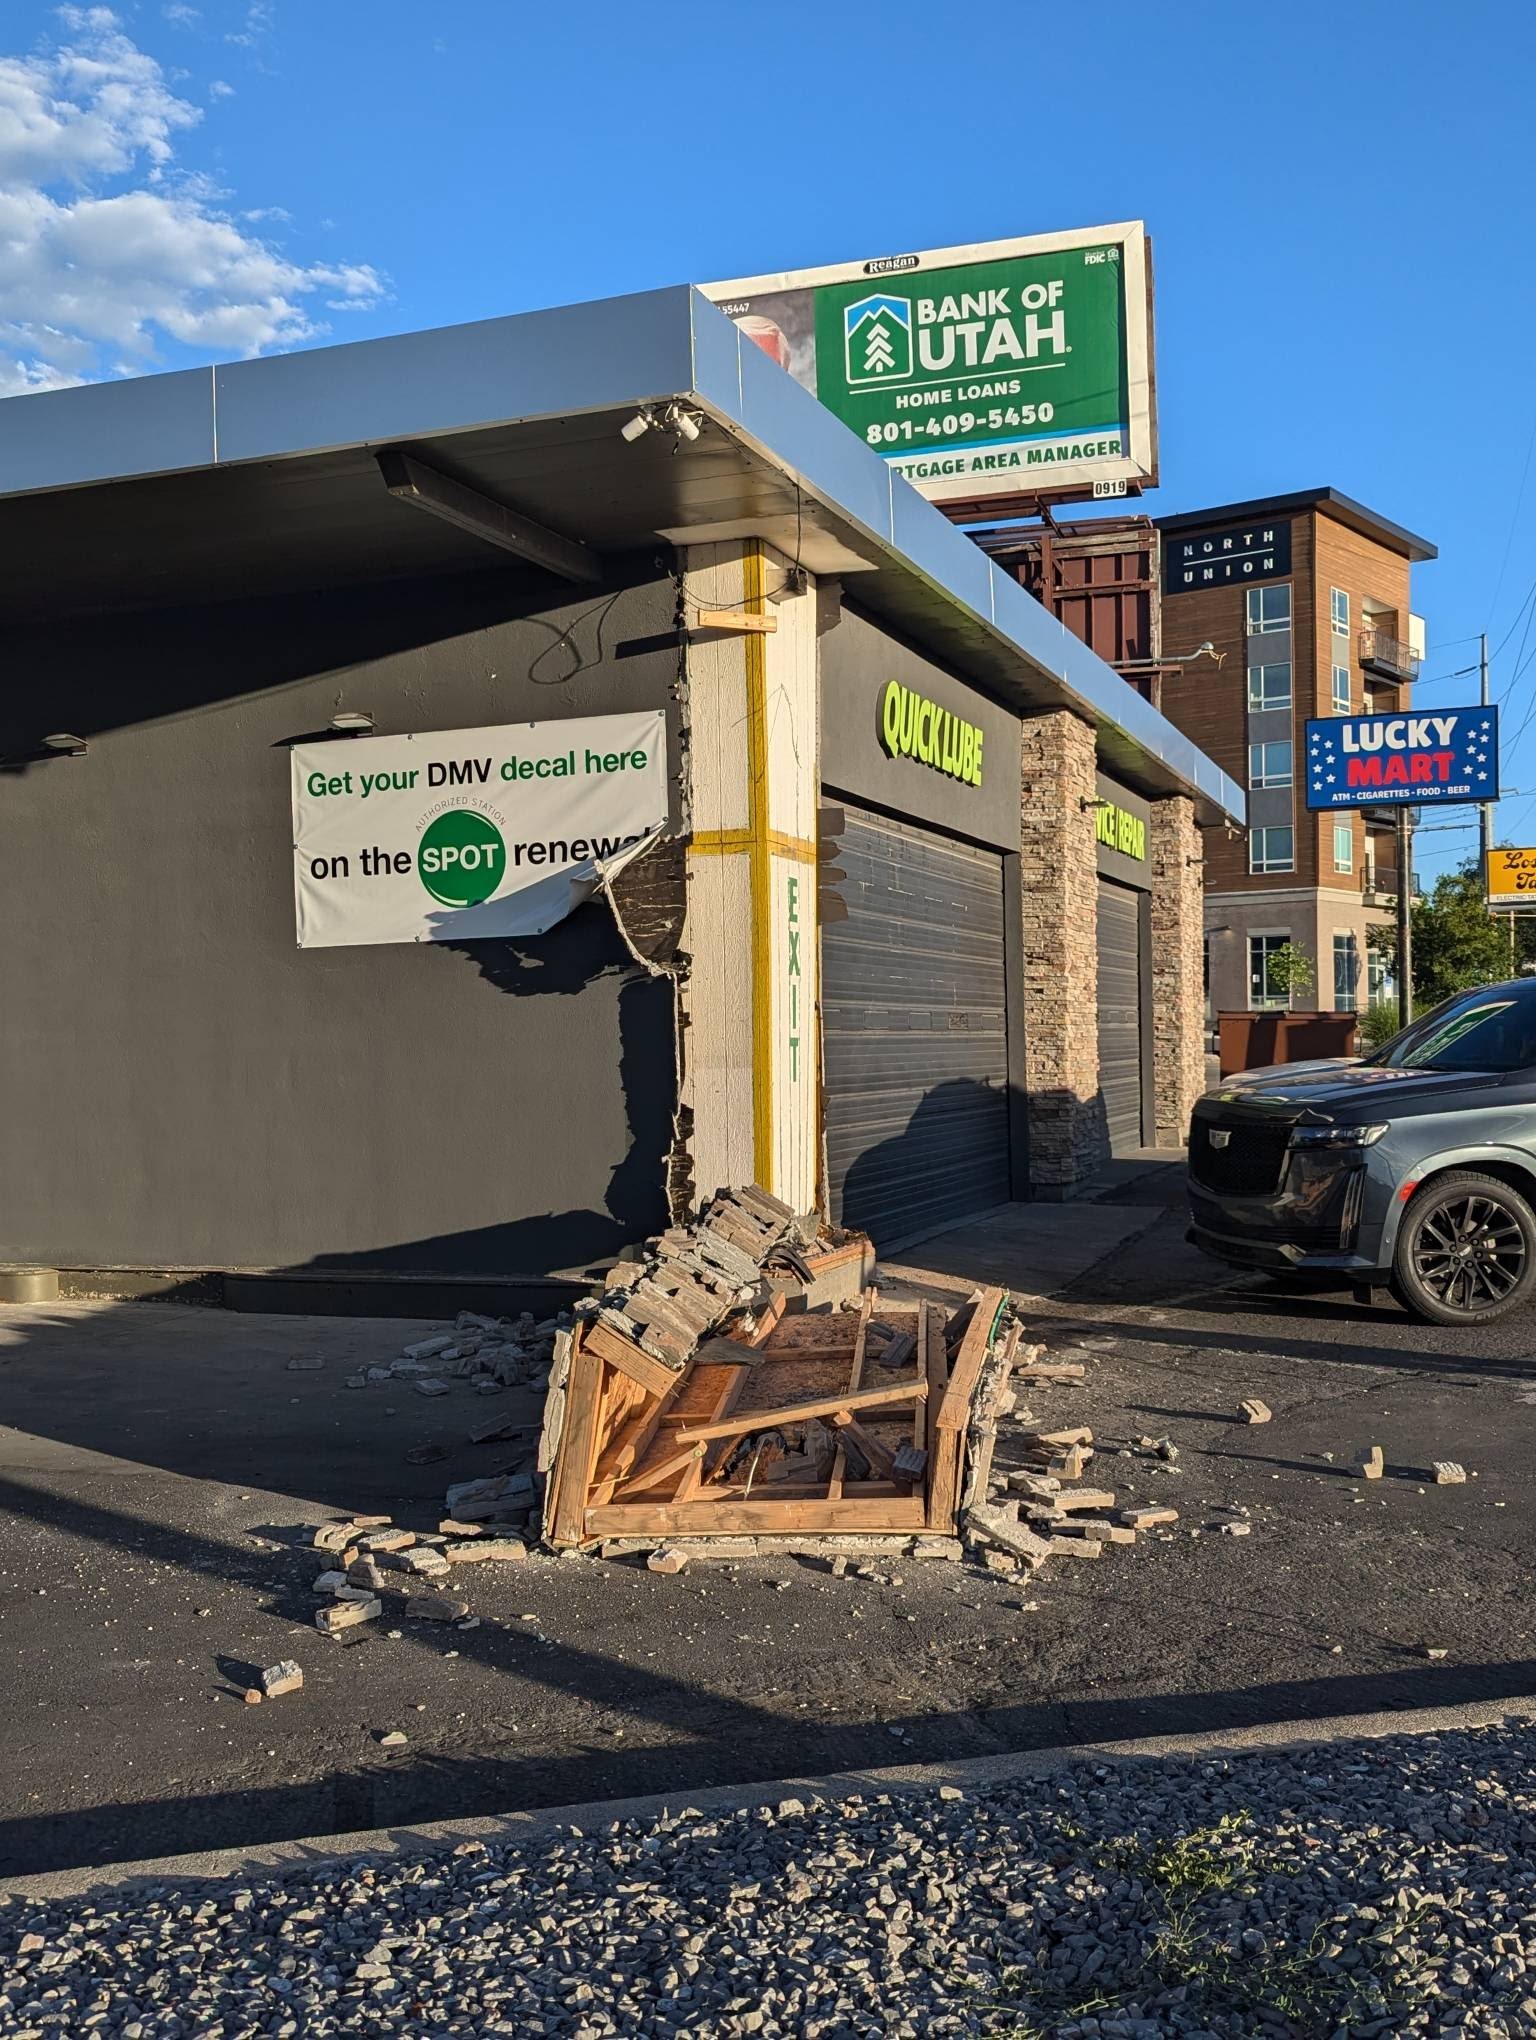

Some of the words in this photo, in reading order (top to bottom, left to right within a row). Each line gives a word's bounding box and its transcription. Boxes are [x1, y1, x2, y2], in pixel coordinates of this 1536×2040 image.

[869, 256, 916, 273] Reagan
[1084, 254, 1106, 266] FDIC
[717, 302, 750, 315] 55447
[917, 287, 1012, 325] BANK
[1021, 280, 1064, 310] OF
[896, 389, 952, 409] HOME
[957, 380, 1021, 401] LOANS
[866, 402, 1054, 444] 801-409-5450
[892, 459, 965, 479] RTGAGE
[971, 452, 1021, 471] AREA
[1026, 440, 1121, 465] MANAGER
[1094, 480, 1126, 495] 0919
[1183, 530, 1274, 556] NORTH
[1183, 558, 1274, 583] UNION
[883, 680, 944, 768] QUICK
[942, 711, 983, 787] LUBE
[1342, 716, 1459, 753] LUCKY
[307, 771, 353, 797] Get
[360, 769, 420, 799] your
[427, 757, 492, 787] DMV
[500, 750, 576, 781] decal
[585, 749, 648, 774] here
[1347, 752, 1455, 787] MART
[1331, 792, 1351, 801] ATM
[1356, 789, 1410, 800] CIGARETTES
[1416, 787, 1441, 797] FOOD
[1447, 785, 1471, 795] BEER
[415, 796, 469, 832] AUTHORIZED
[471, 797, 507, 827] STATION
[310, 855, 349, 880] on
[359, 846, 412, 876] the
[422, 843, 499, 873] SPOT
[513, 826, 650, 867] renew
[787, 876, 801, 1083] EXIT
